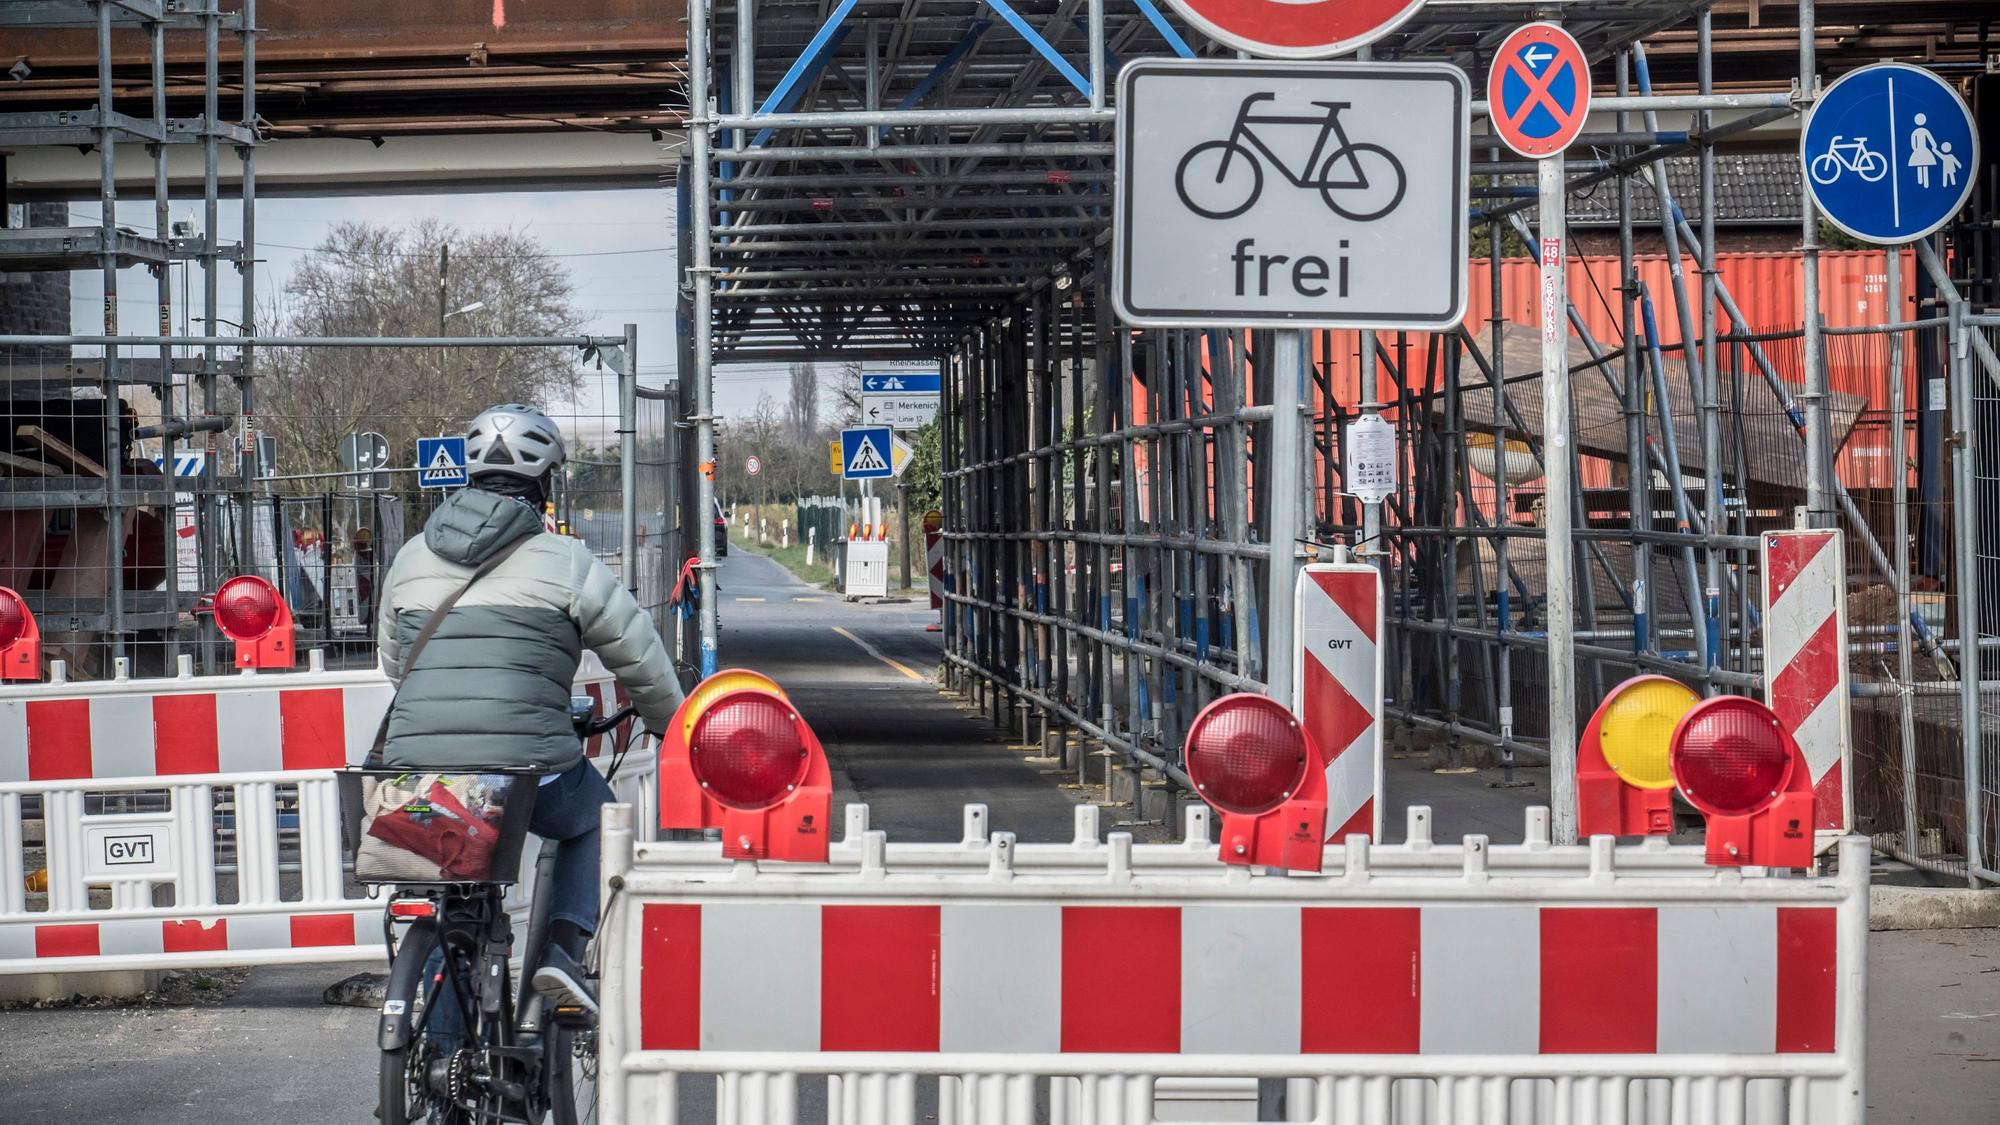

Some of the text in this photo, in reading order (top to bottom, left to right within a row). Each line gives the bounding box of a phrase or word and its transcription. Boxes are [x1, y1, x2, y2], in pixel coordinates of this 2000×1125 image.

[1544, 246, 1558, 259] 48
[1231, 238, 1349, 297] frei
[105, 297, 111, 311] UP
[161, 306, 169, 320] UP
[247, 416, 253, 429] UP
[1328, 639, 1353, 649] GVT
[109, 842, 150, 858] GVT
